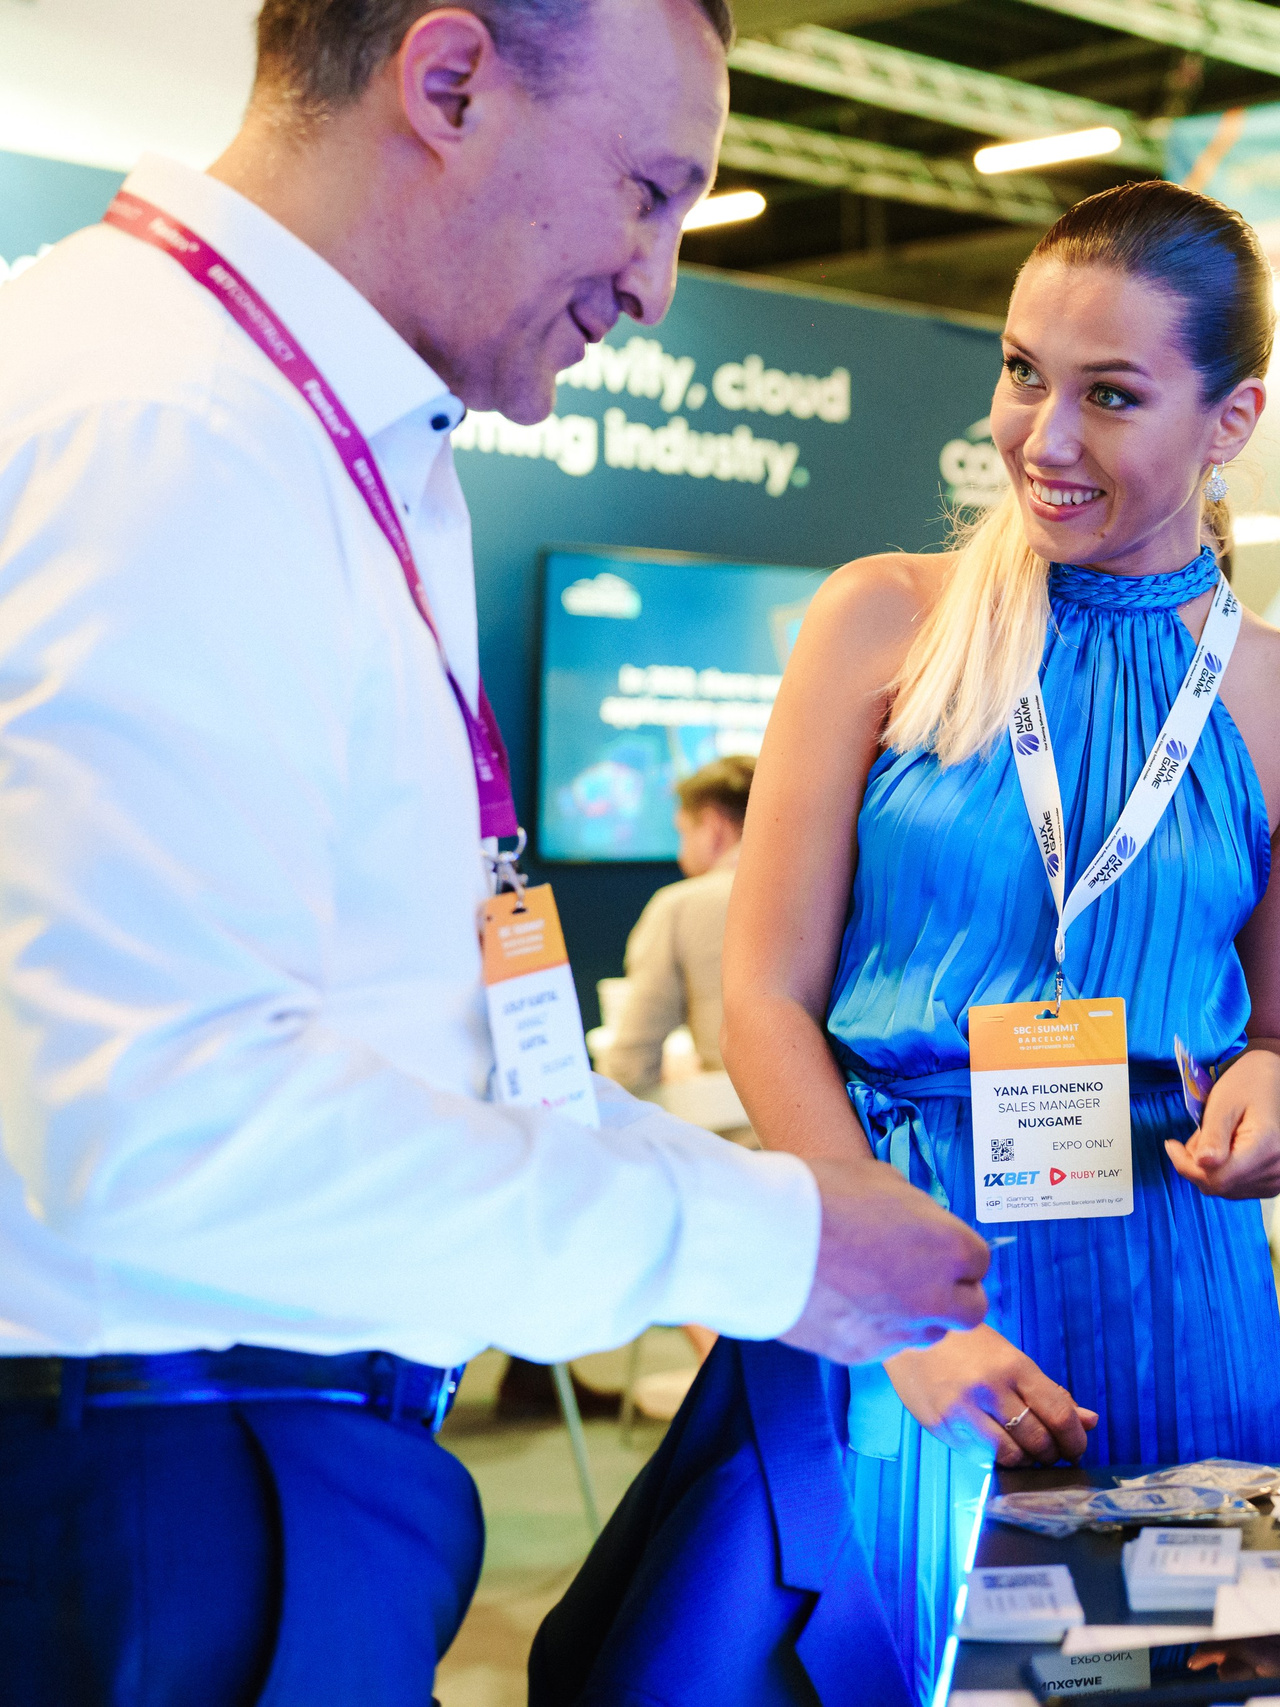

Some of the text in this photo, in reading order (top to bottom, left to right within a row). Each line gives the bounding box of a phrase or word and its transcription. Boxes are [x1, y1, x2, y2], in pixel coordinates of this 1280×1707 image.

[712, 354, 851, 423] cloud
[1192, 668, 1209, 698] GAME
[1203, 672, 1216, 694] NUX
[1014, 708, 1025, 734] NUX
[1020, 696, 1034, 732] GAME
[1152, 756, 1171, 790] GAME
[1163, 760, 1180, 783] NUX
[1039, 826, 1050, 854] NUX
[1043, 810, 1056, 852] GAME
[1088, 854, 1117, 889] GAME
[1100, 858, 1122, 884] NUX
[1013, 1024, 1080, 1035] SBC SUMMIT
[1018, 1035, 1076, 1044] BARCELONA
[993, 1081, 1104, 1097] YANA FILONENKO
[998, 1098, 1101, 1114] SALES MANAGER
[1018, 1116, 1083, 1128] NUXGAME
[1052, 1138, 1114, 1151] EXPO ONLY
[983, 1170, 1040, 1188] 1XBET
[1070, 1170, 1096, 1180] RUBY
